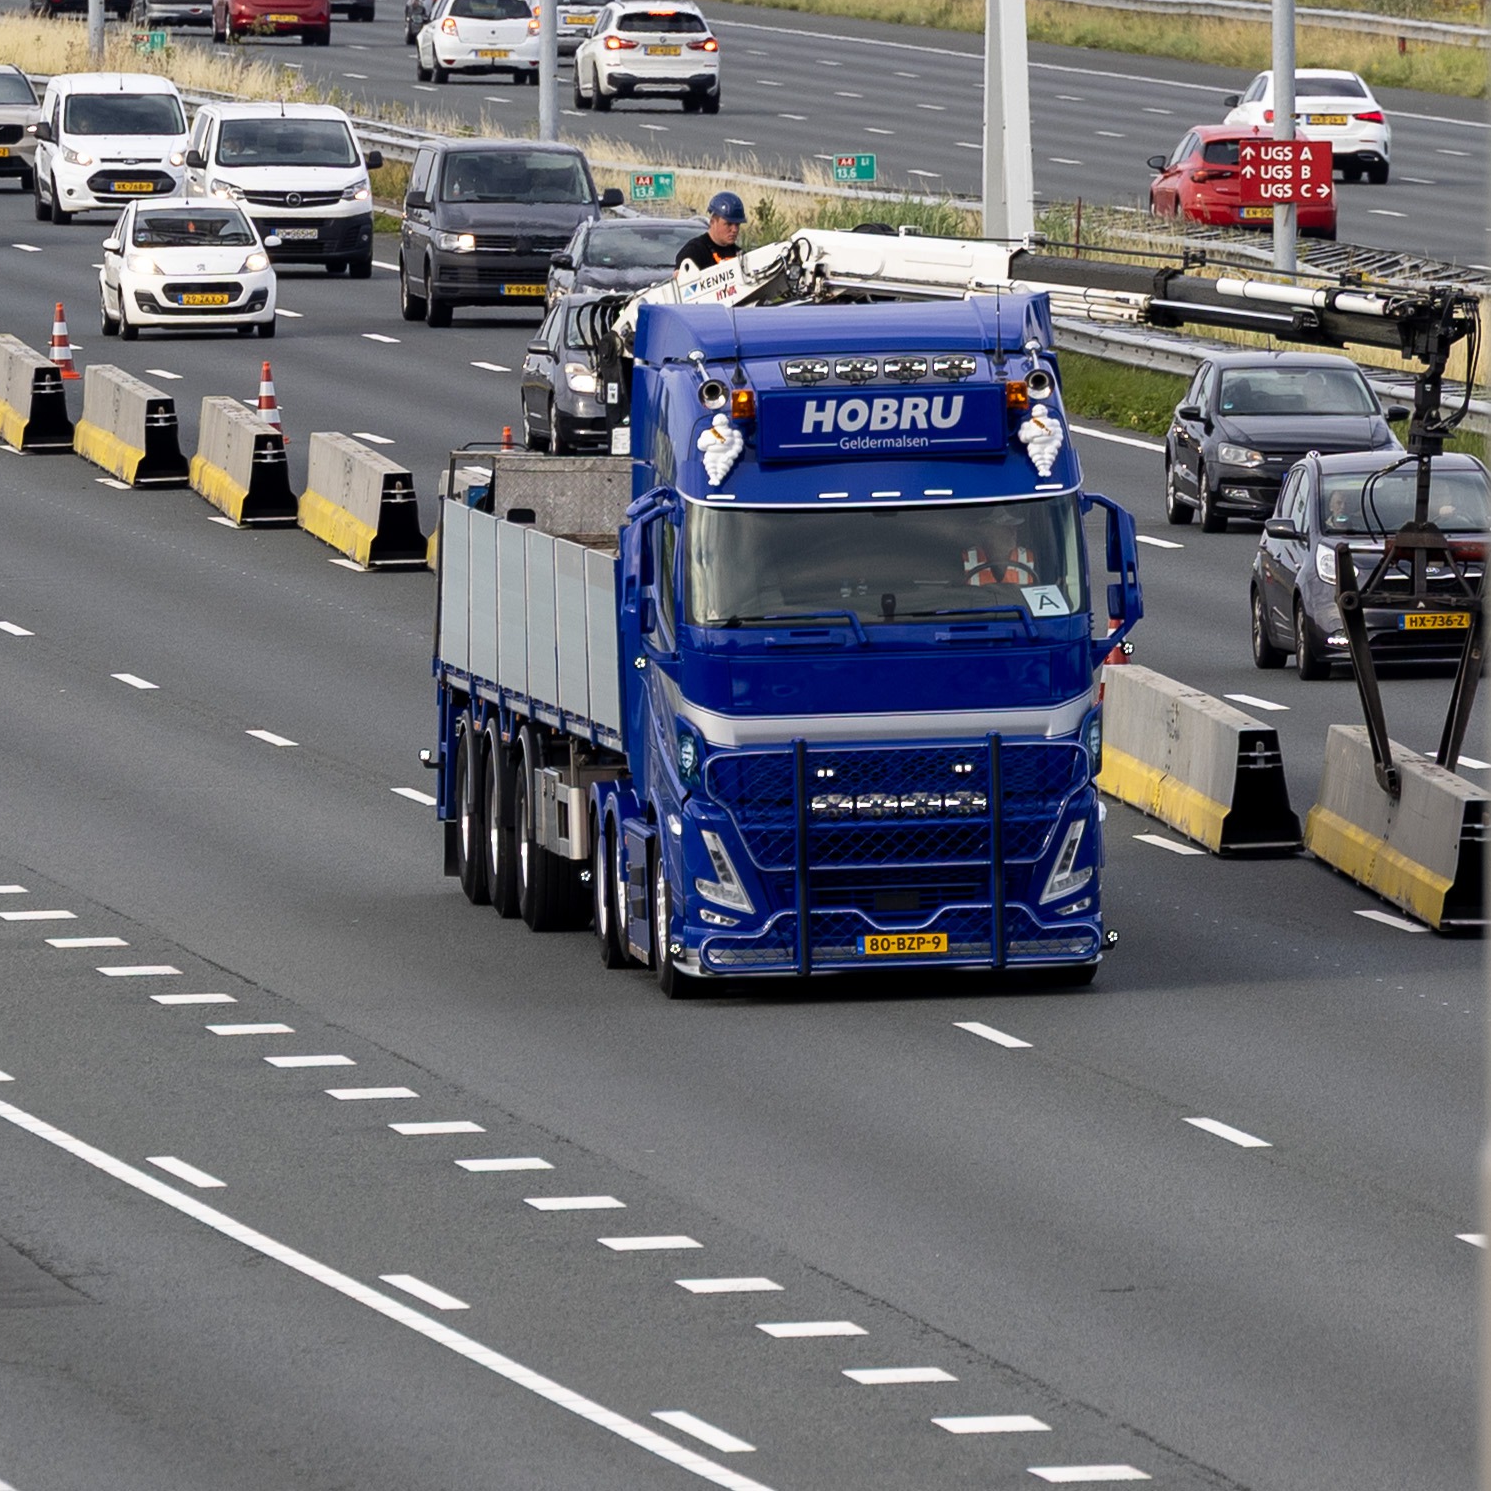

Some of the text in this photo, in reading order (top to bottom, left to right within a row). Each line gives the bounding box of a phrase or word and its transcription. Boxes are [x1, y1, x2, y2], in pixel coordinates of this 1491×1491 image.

[1259, 146, 1314, 161] UGS A
[840, 158, 854, 166] A4
[1259, 164, 1312, 180] UGS B
[638, 177, 651, 185] A4
[1259, 183, 1313, 198] UGS C
[699, 269, 735, 292] KENNIS
[801, 395, 965, 434] HOBRU
[839, 435, 929, 451] Geldermalsen
[1038, 594, 1061, 611] A
[1408, 614, 1466, 627] HX-736-Z
[869, 935, 942, 952] 80-BZP-9
